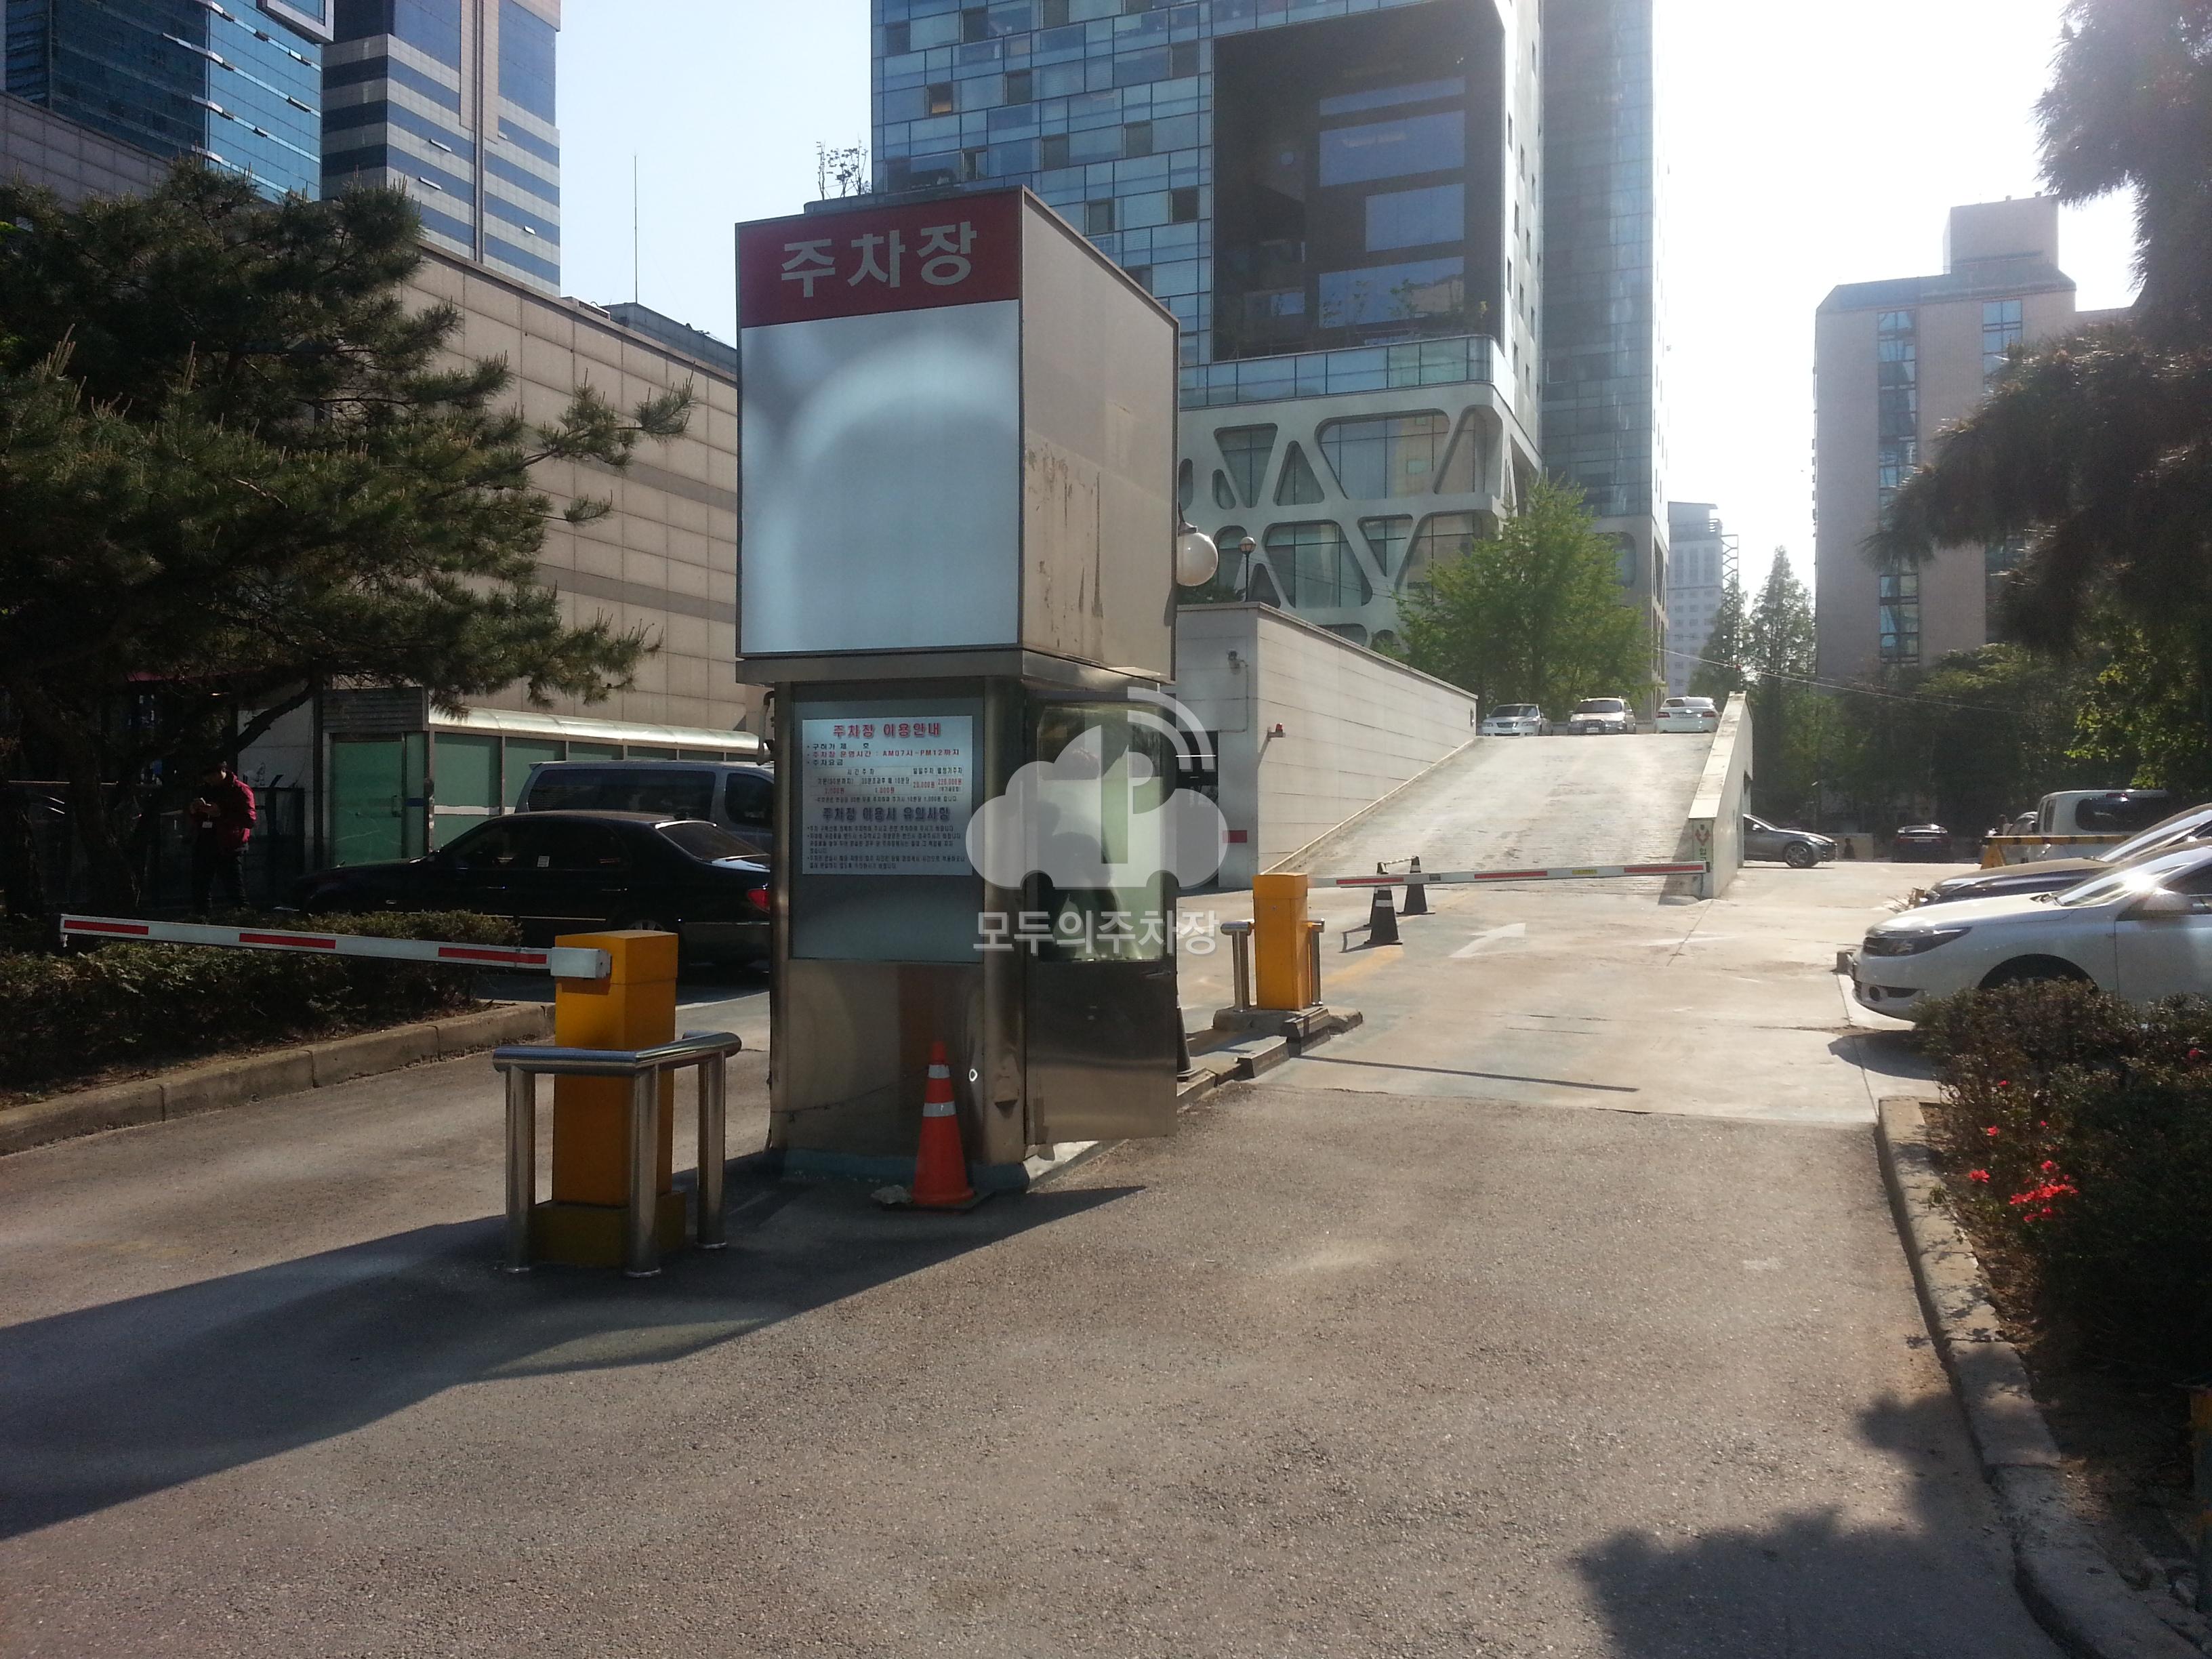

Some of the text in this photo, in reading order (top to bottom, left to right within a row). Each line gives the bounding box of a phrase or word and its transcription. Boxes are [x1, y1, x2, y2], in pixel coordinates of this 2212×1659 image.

[781, 222, 977, 298] 주차장
[834, 722, 941, 739] 주차장 이용안내
[813, 750, 836, 758] 주차장
[823, 806, 950, 823] 주차장 이용시 유의사항
